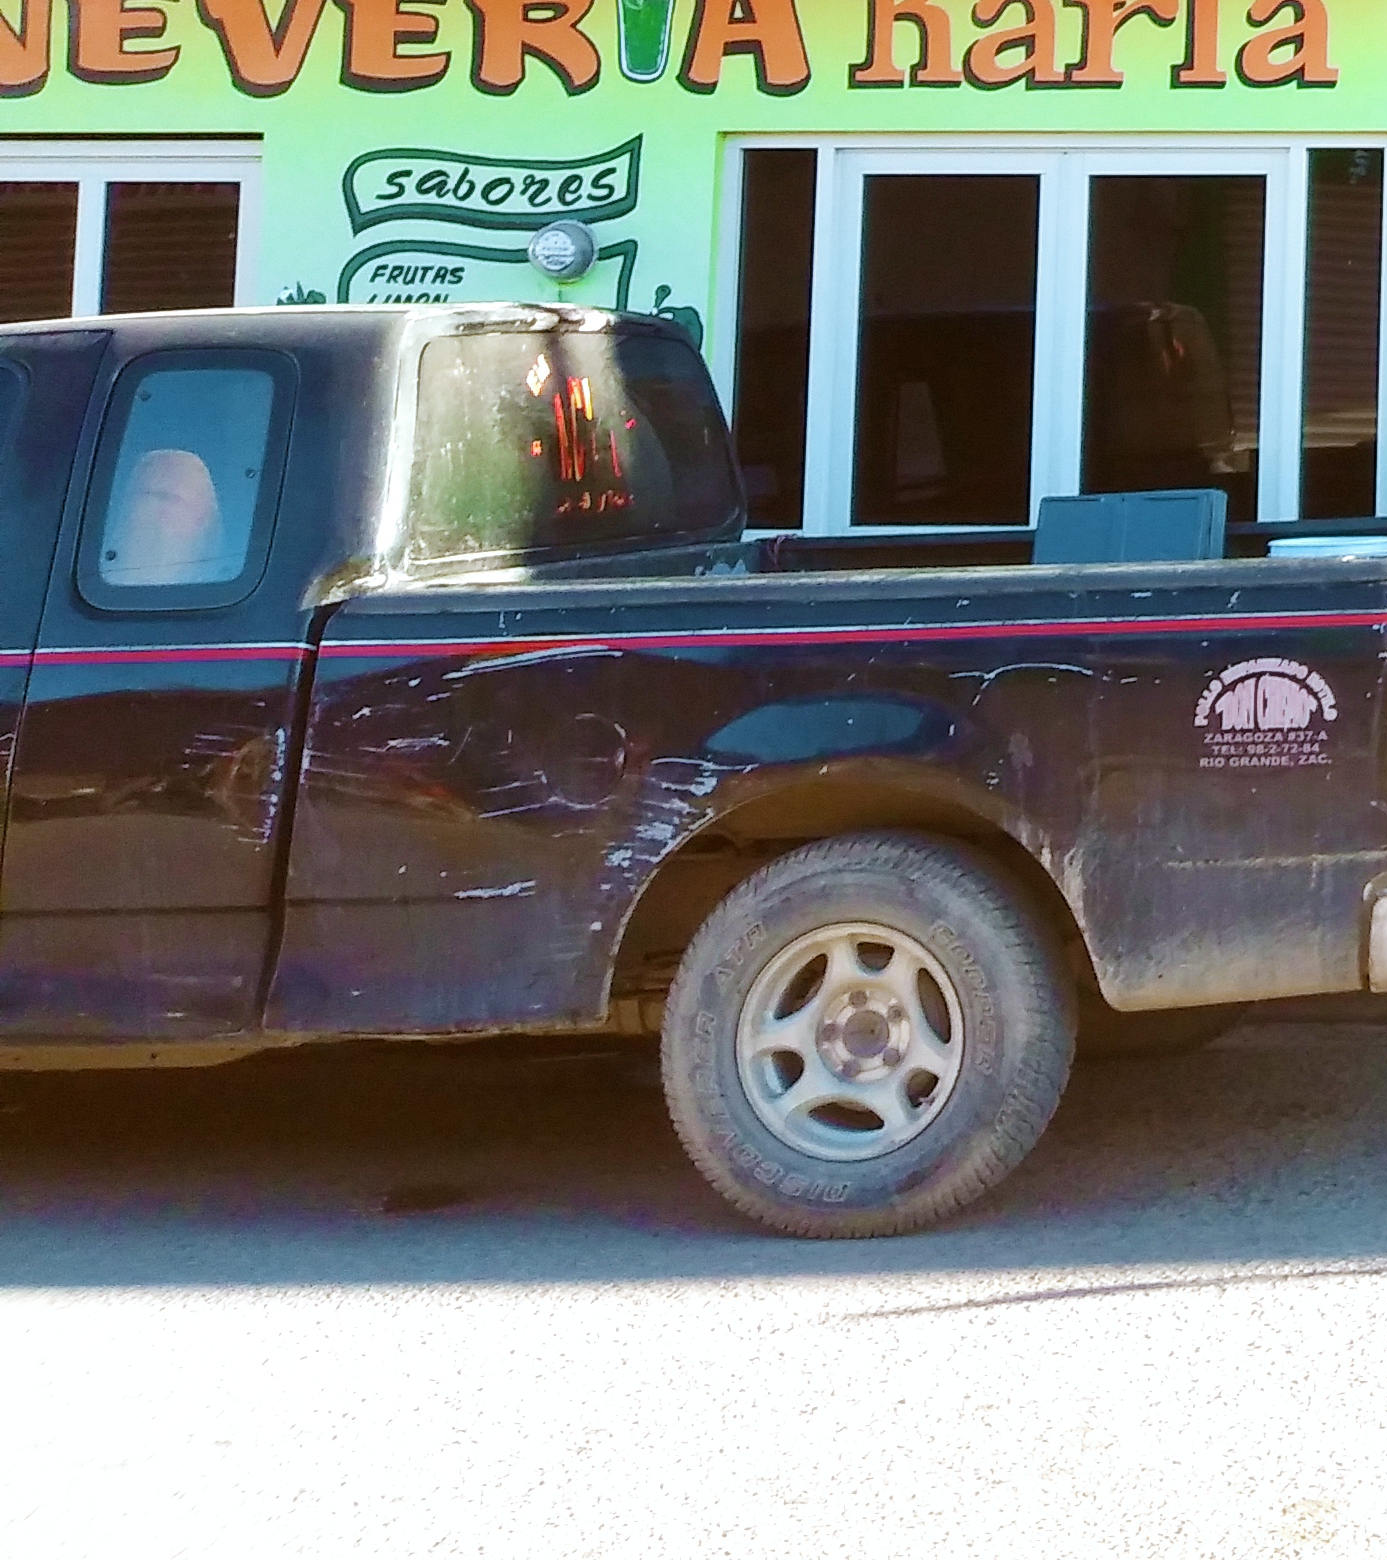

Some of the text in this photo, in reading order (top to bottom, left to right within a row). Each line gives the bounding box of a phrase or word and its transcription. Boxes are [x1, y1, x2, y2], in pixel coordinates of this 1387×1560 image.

[375, 167, 618, 206] sabores
[369, 264, 466, 286] FRUTAS
[1203, 730, 1328, 744] ZARAGOZA #37-A
[1246, 742, 1320, 755] 98-2-72-84
[1199, 756, 1226, 768] RIO
[1228, 755, 1295, 768] GRANDE,
